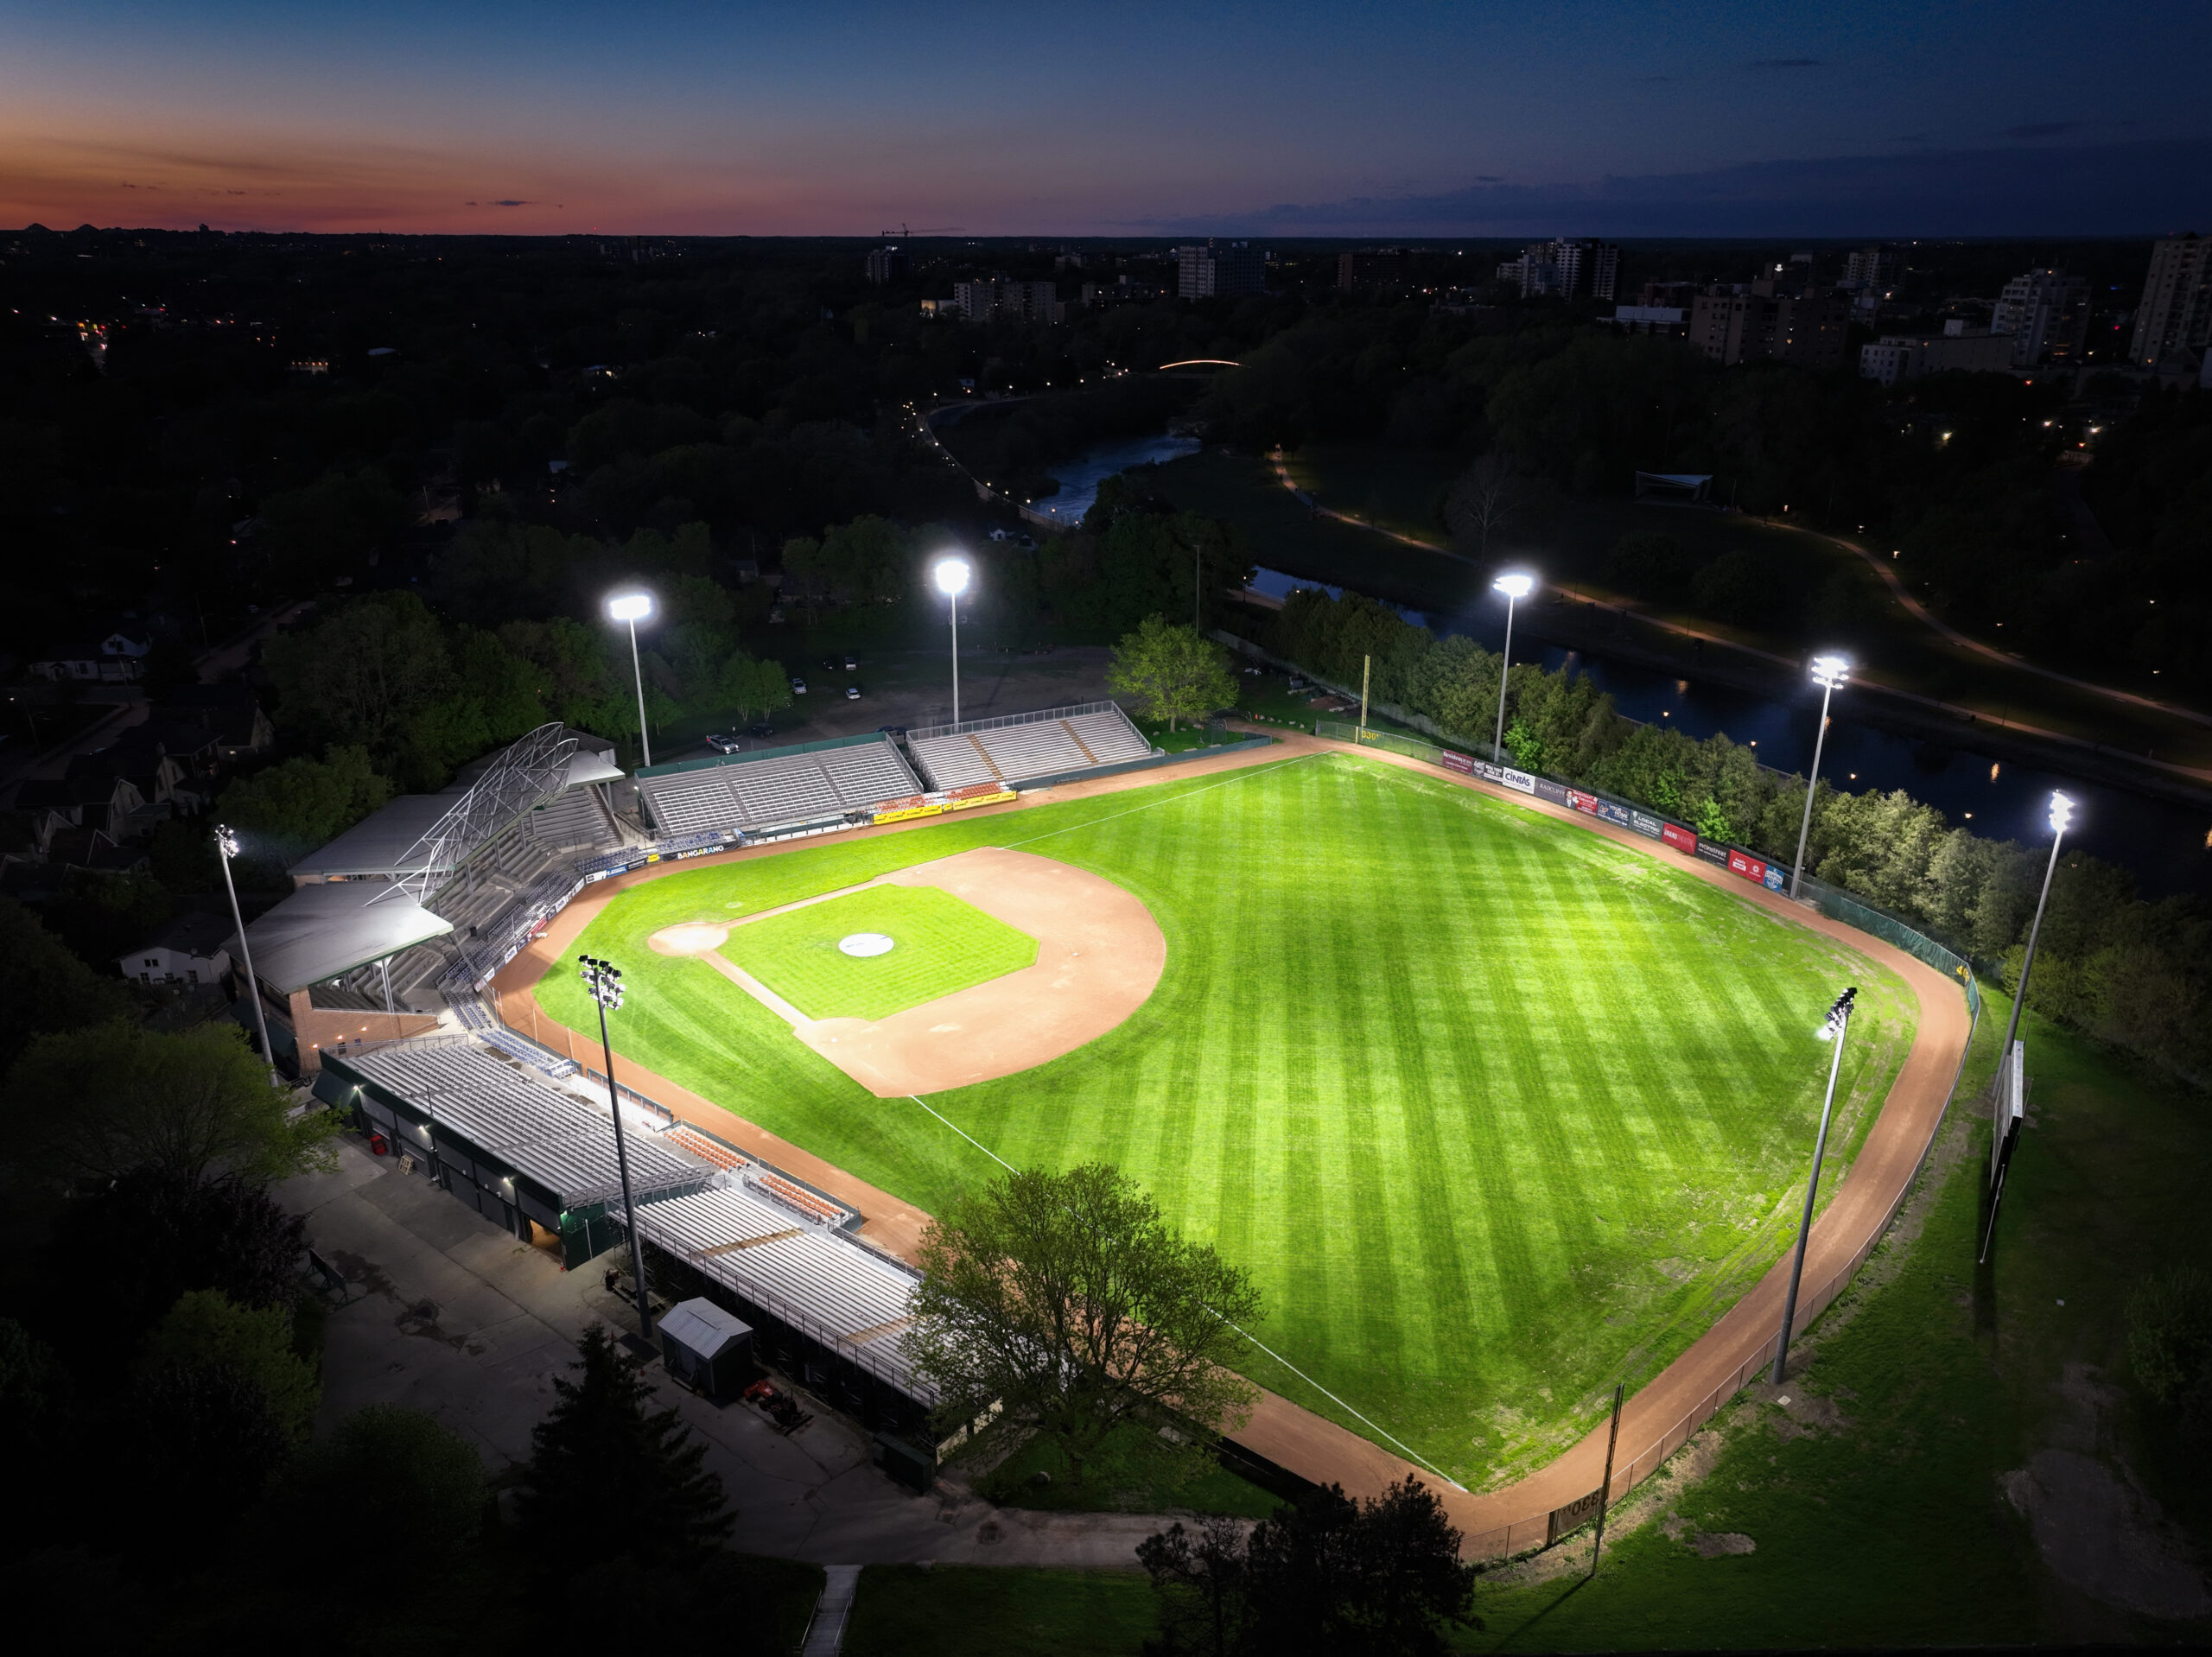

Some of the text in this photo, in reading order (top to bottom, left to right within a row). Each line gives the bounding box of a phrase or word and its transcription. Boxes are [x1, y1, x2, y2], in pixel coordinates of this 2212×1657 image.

[1362, 730, 1376, 740] 330
[1633, 820, 1661, 833] ELECTRIC
[1638, 816, 1656, 827] LOCAL
[677, 845, 724, 860] BANGARANG
[1698, 842, 1726, 858] mainstreet
